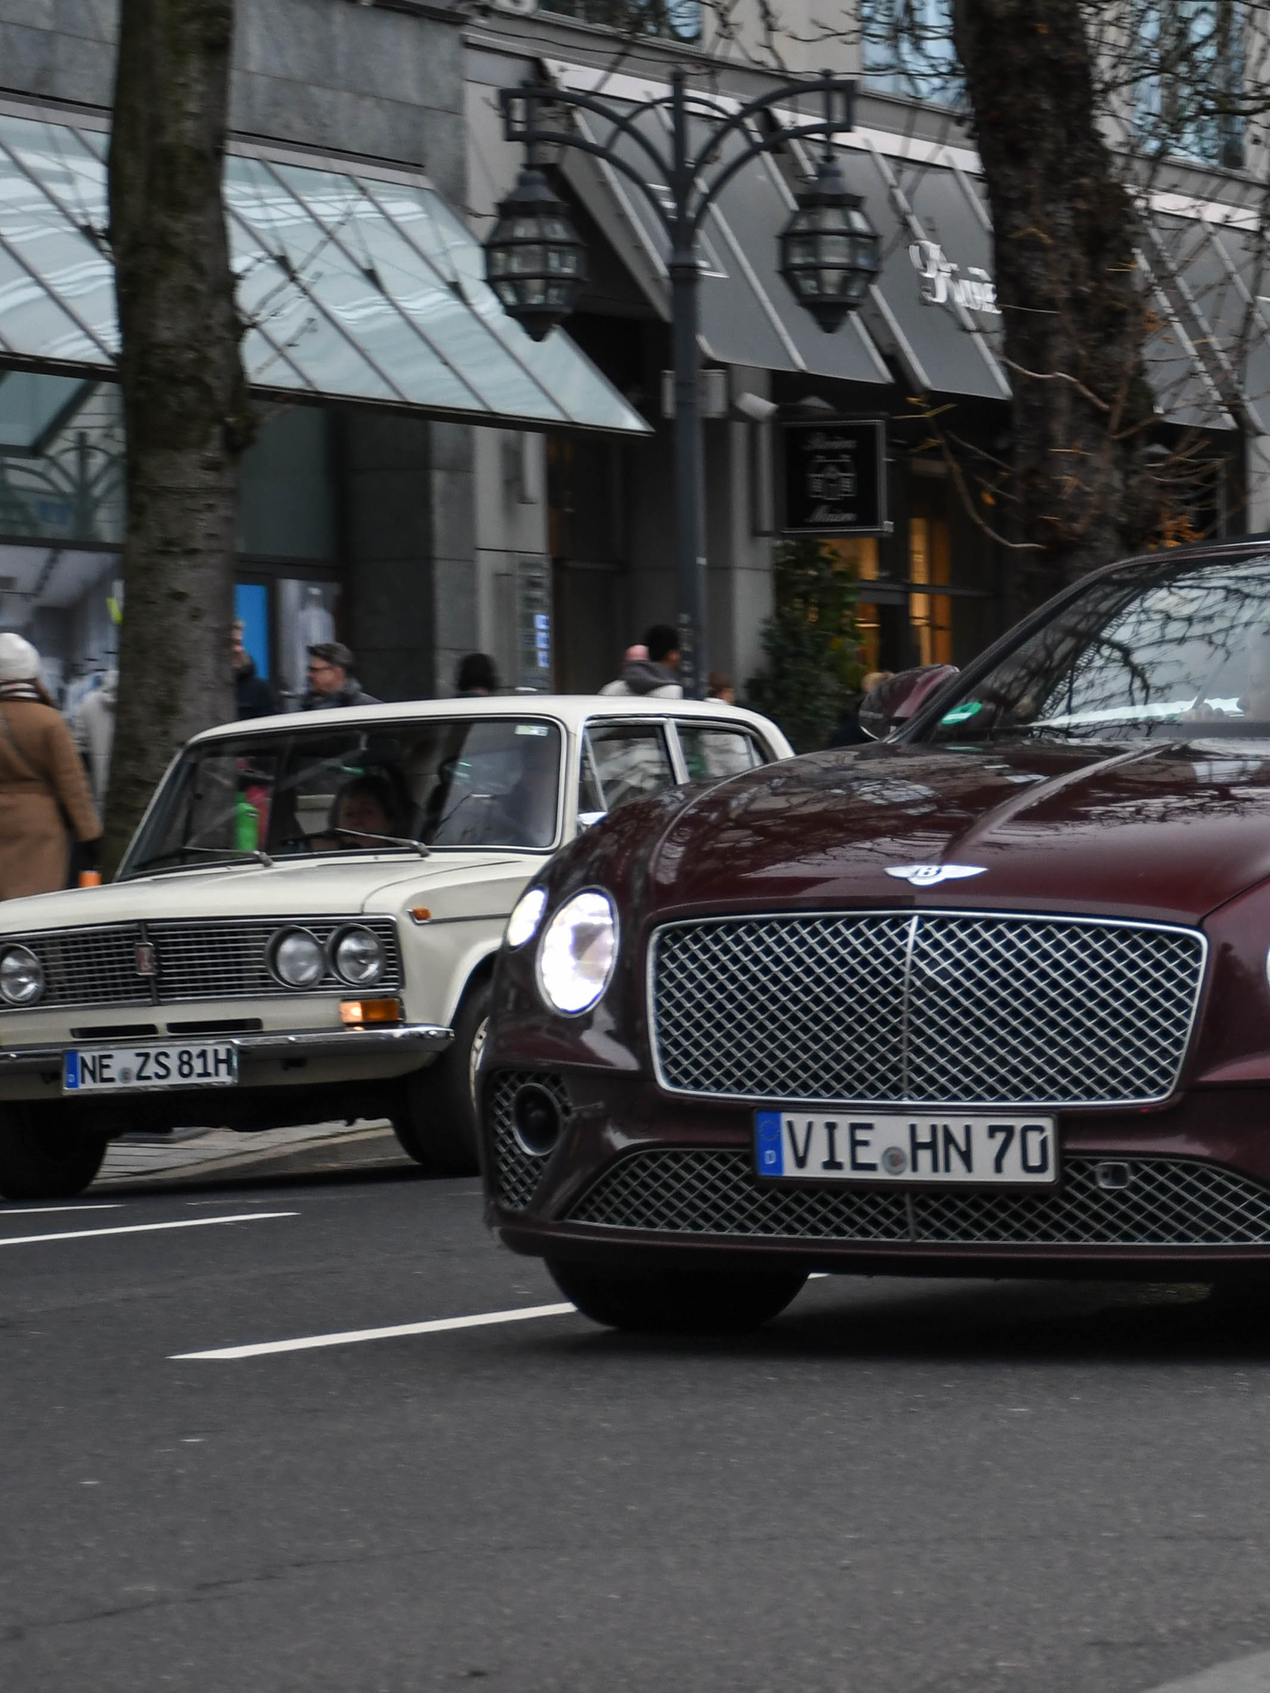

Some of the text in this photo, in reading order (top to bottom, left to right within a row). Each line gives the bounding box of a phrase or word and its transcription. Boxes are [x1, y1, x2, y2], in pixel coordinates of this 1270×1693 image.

[80, 1048, 233, 1084] NE ZS 81H
[786, 1120, 1049, 1173] VIE HN 70
